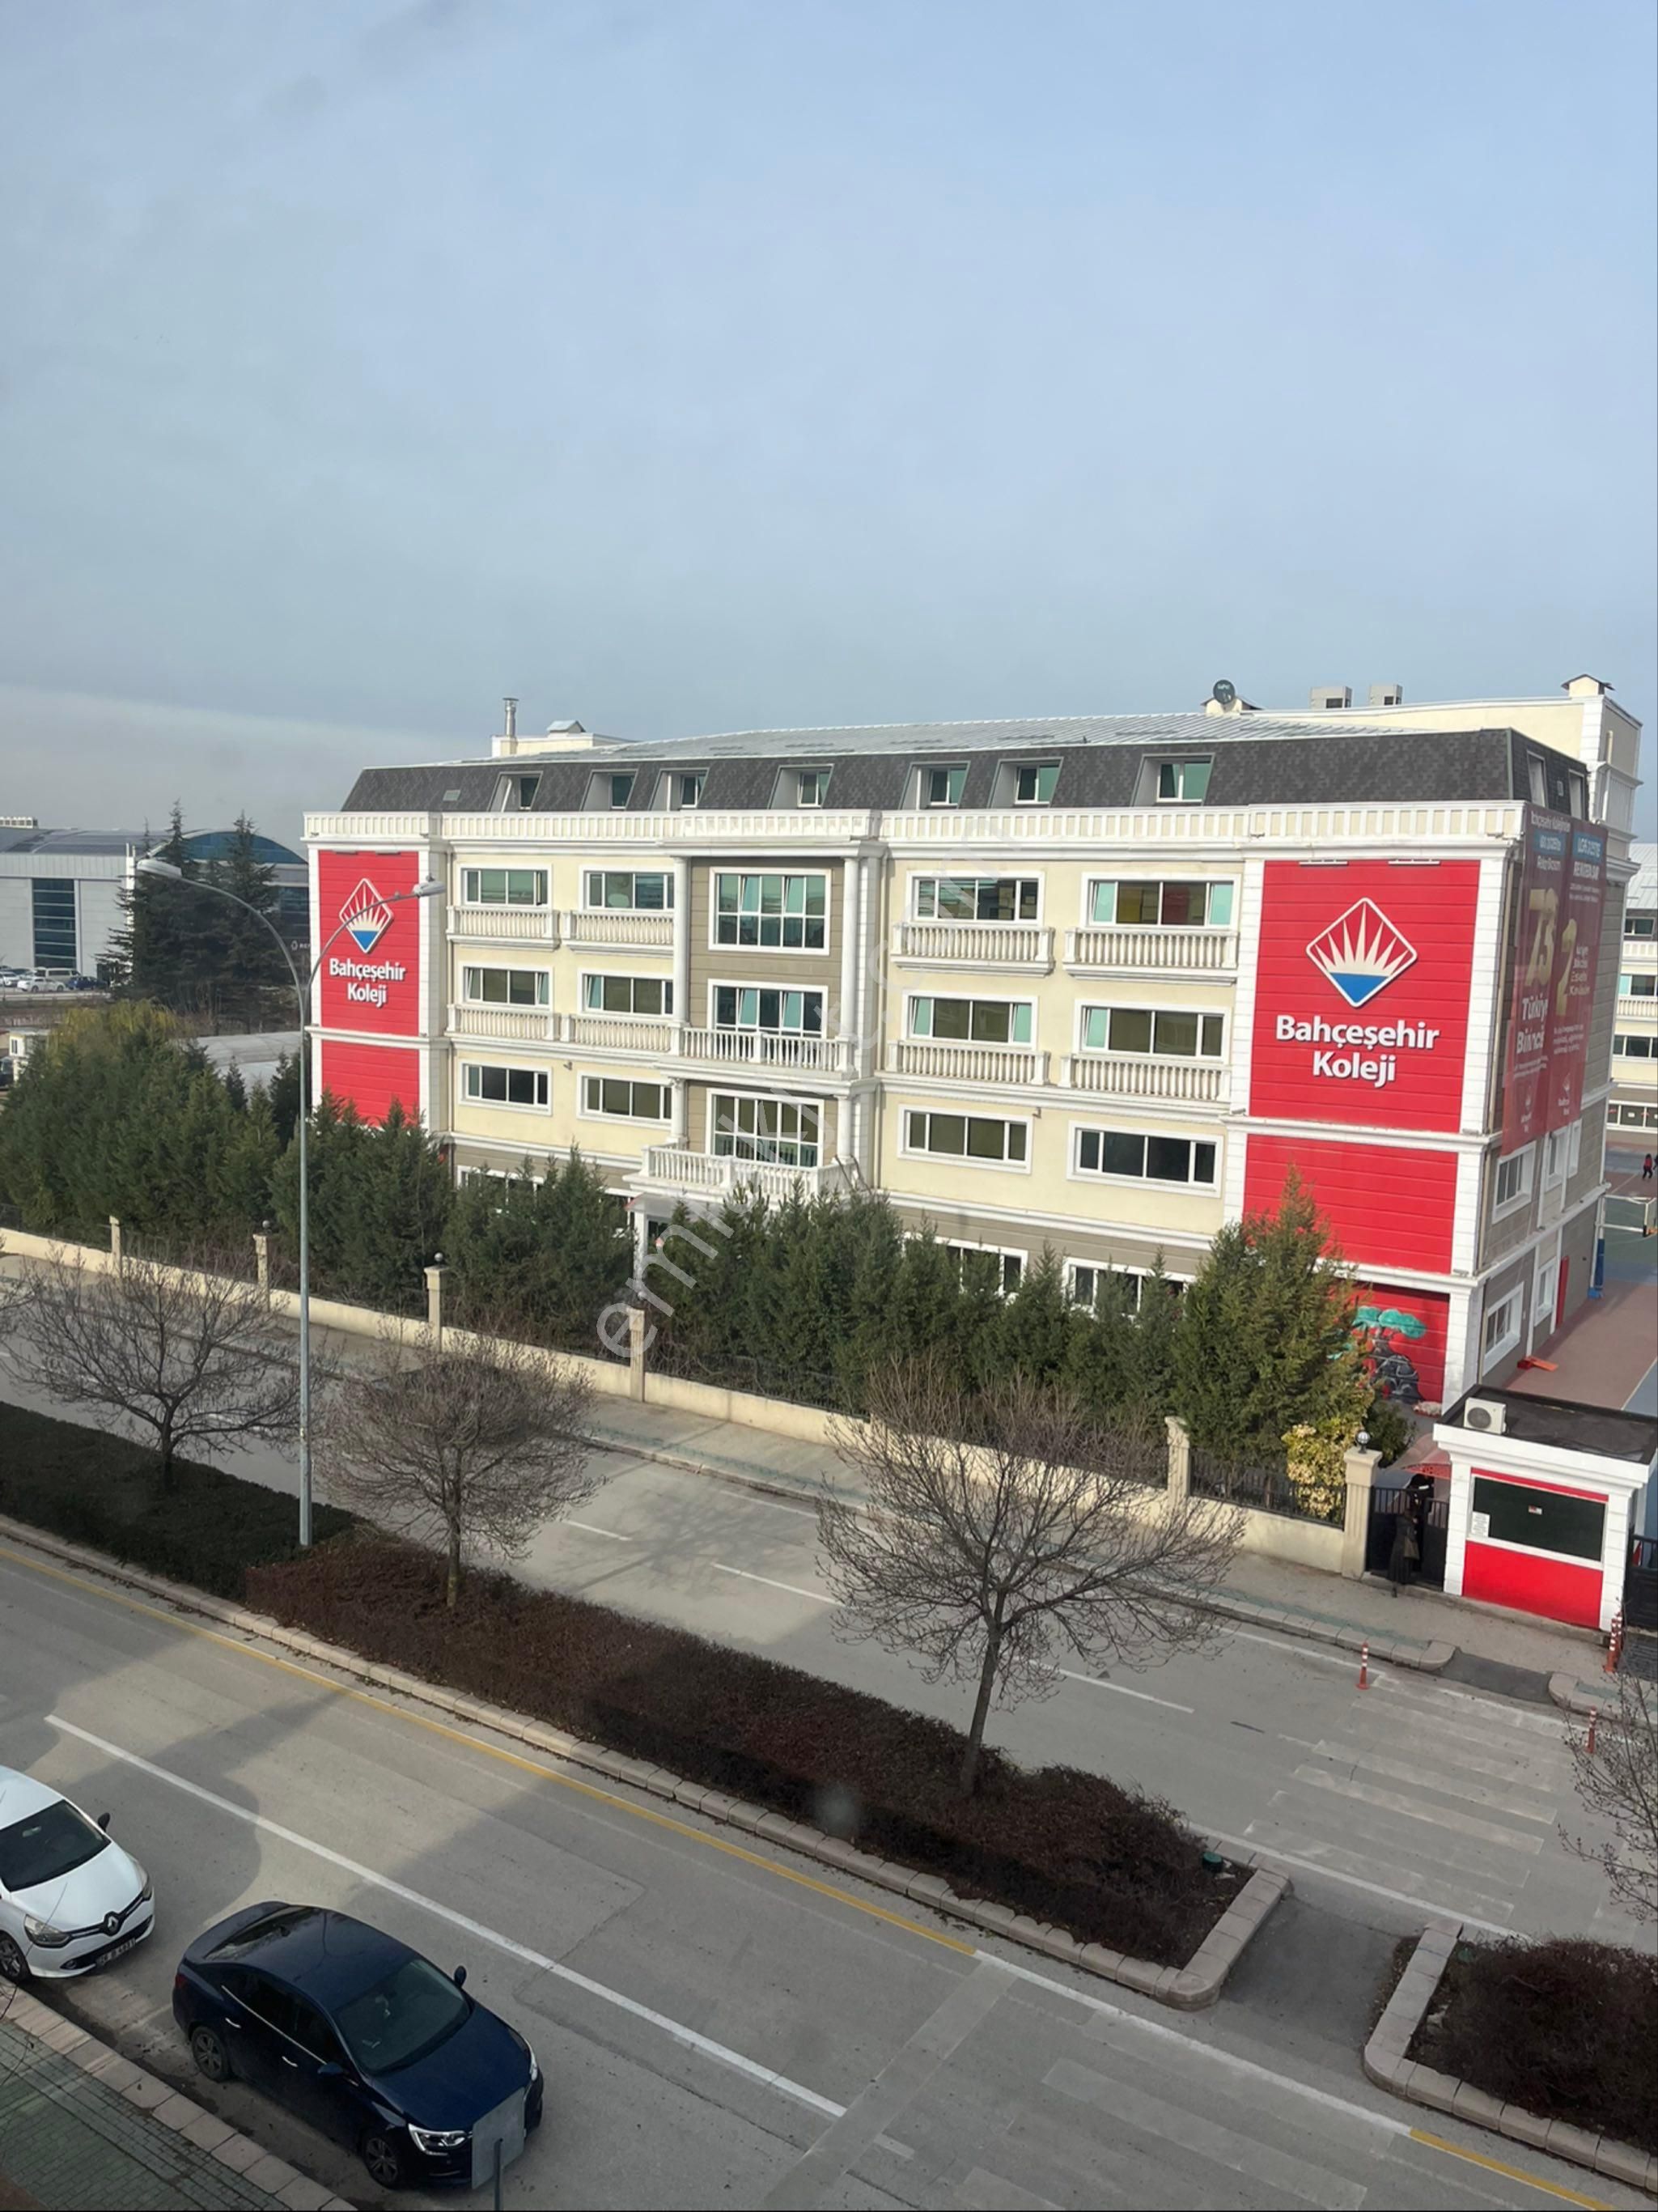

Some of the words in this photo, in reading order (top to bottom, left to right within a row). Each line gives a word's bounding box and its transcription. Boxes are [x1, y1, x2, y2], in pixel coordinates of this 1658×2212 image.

[329, 957, 405, 982] Bahçeşehir
[347, 982, 387, 1008] Koleji
[1276, 1015, 1440, 1050] Bahçeşehir
[1312, 1051, 1397, 1088] Koleji
